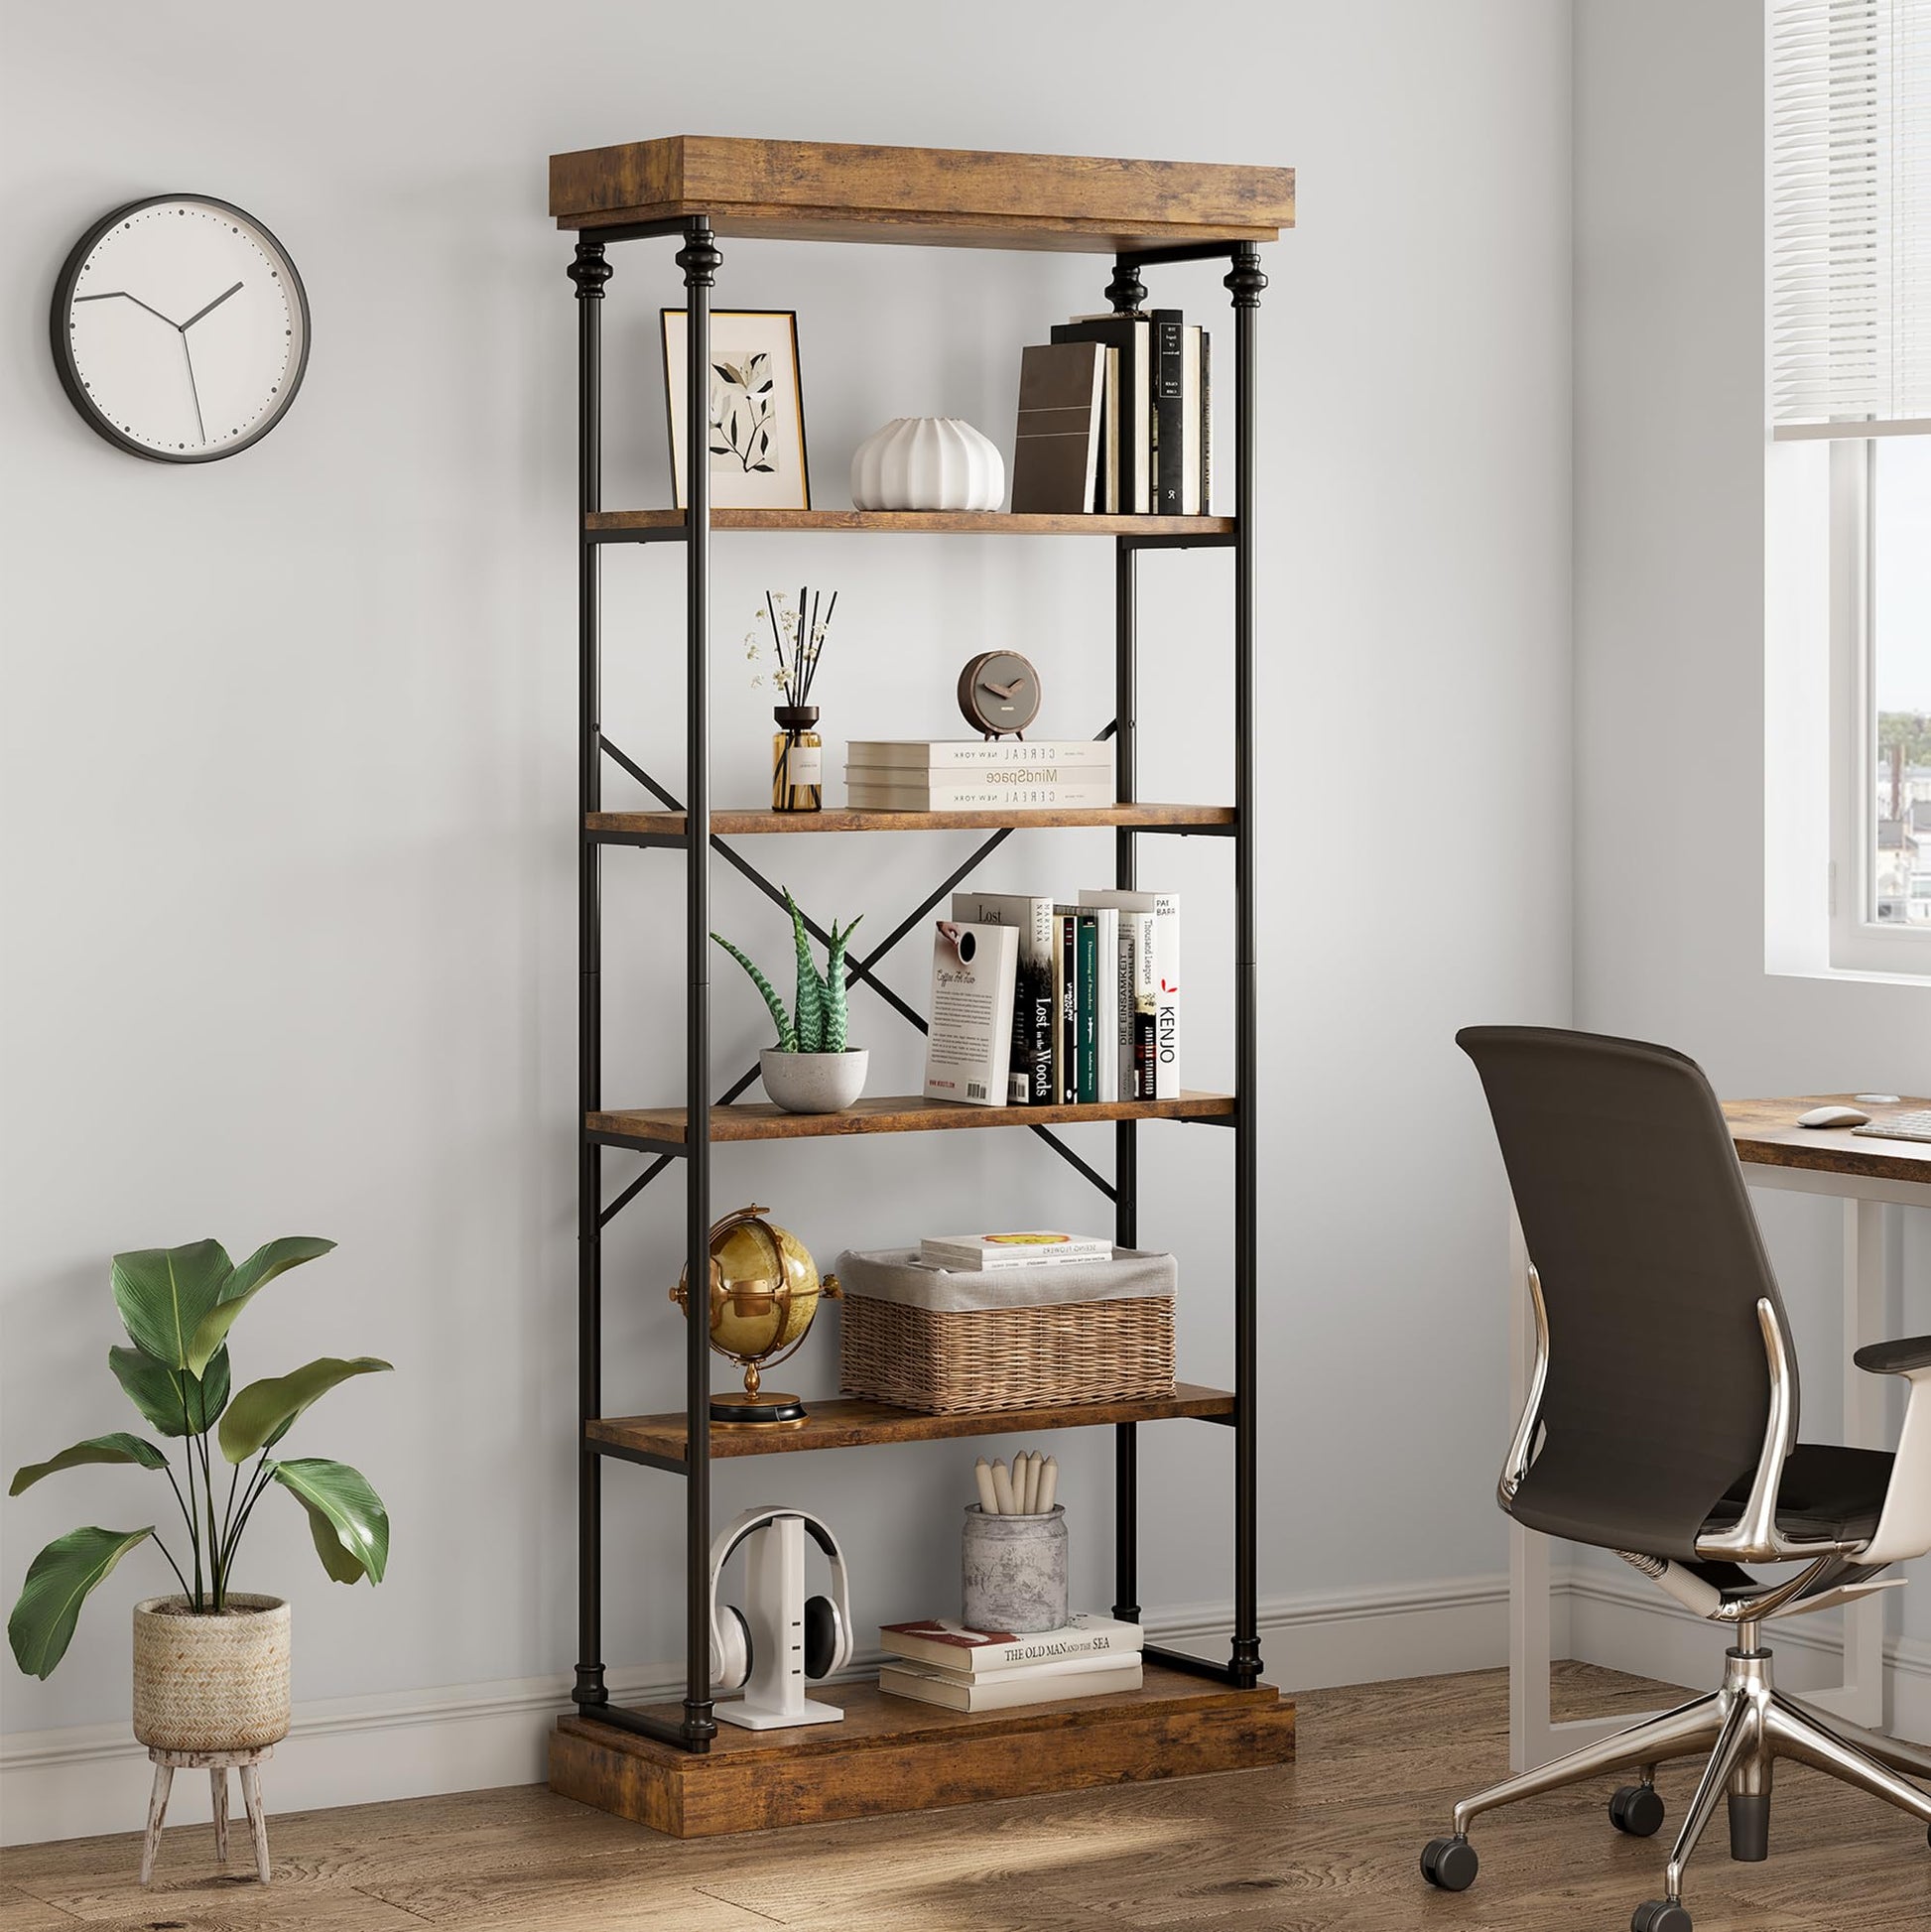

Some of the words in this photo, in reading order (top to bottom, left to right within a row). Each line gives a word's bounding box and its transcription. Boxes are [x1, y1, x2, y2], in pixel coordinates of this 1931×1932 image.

[977, 904, 1002, 923] Lost
[1036, 997, 1052, 1028] Lost
[1036, 1039, 1045, 1050] the
[1160, 1006, 1175, 1063] KENJO
[1036, 1048, 1052, 1096] Woods
[1004, 1648, 1024, 1661] THE
[1025, 1645, 1045, 1659] OLD
[1046, 1641, 1067, 1656] MAN
[1067, 1644, 1080, 1653] AND
[1080, 1642, 1091, 1651] THE
[1093, 1637, 1110, 1650] SEA
